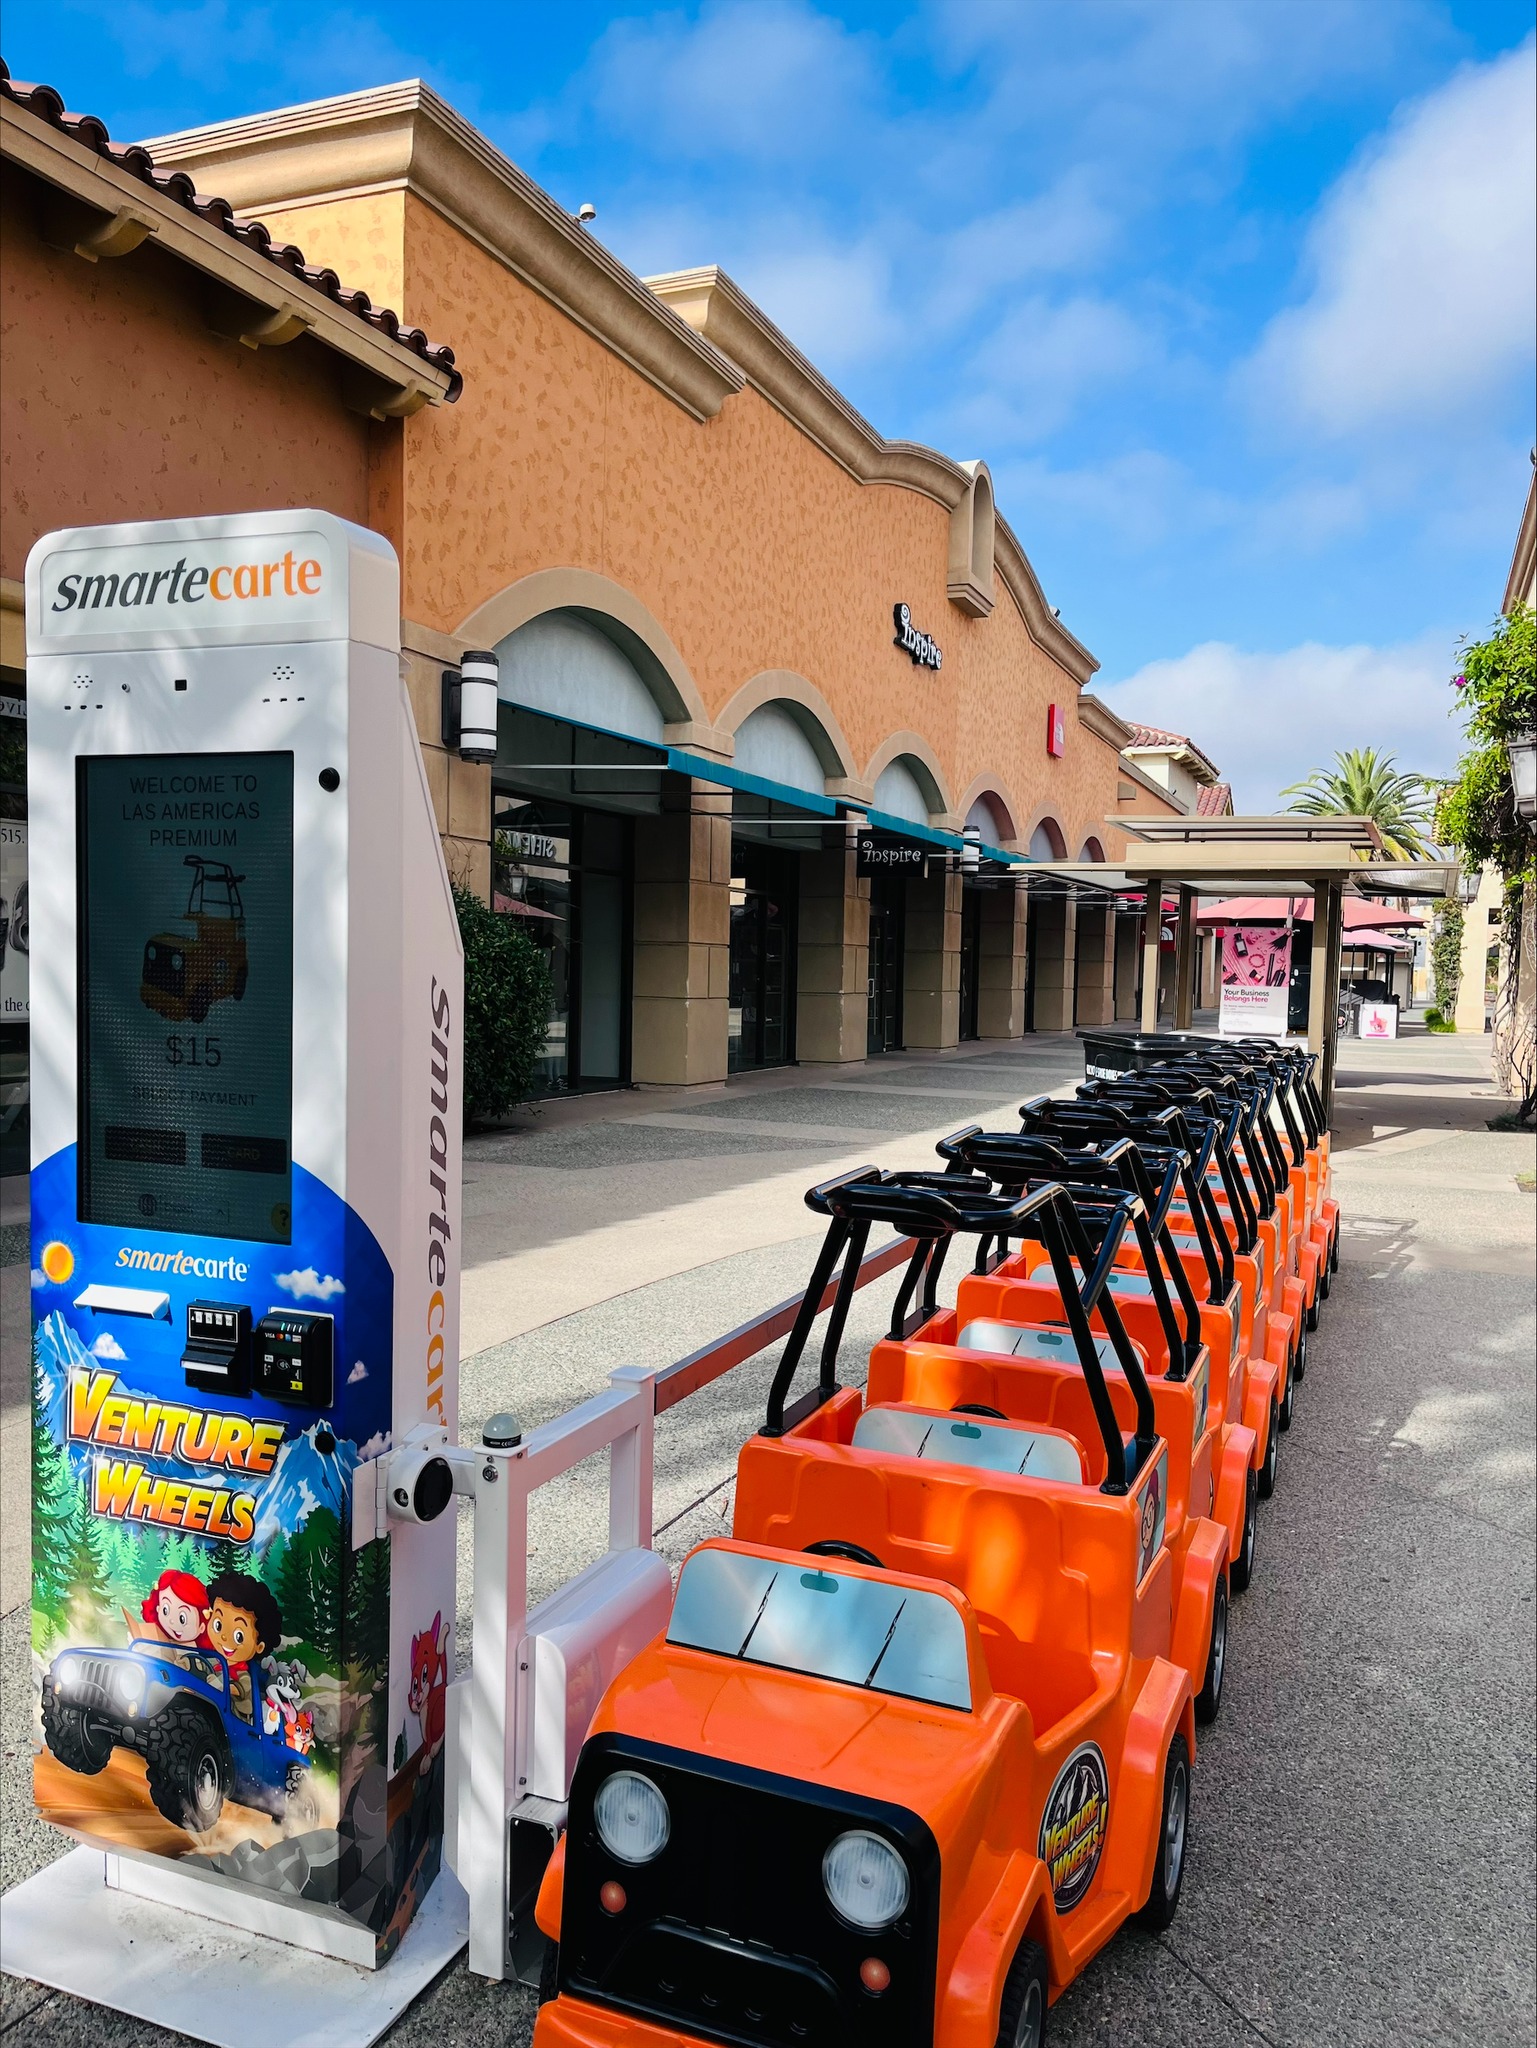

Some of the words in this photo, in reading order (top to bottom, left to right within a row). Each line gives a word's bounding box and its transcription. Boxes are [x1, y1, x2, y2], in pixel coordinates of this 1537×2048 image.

[51, 550, 323, 612] smartecarte
[130, 775, 225, 794] WELCOME
[232, 774, 258, 793] TO
[122, 803, 156, 821] LAS
[162, 802, 260, 820] AMERICAS
[150, 829, 237, 847] PREMIUM
[5, 996, 23, 1012] the
[1223, 994, 1250, 1003] Belongs
[165, 1035, 222, 1068] $15
[190, 1089, 258, 1106] PAYMENT
[425, 974, 453, 1427] smartecar
[115, 1247, 249, 1282] smartecarte
[68, 1366, 289, 1476] VENTURE
[92, 1455, 257, 1543] WHEELS
[1045, 1791, 1100, 1864] VENTURE
